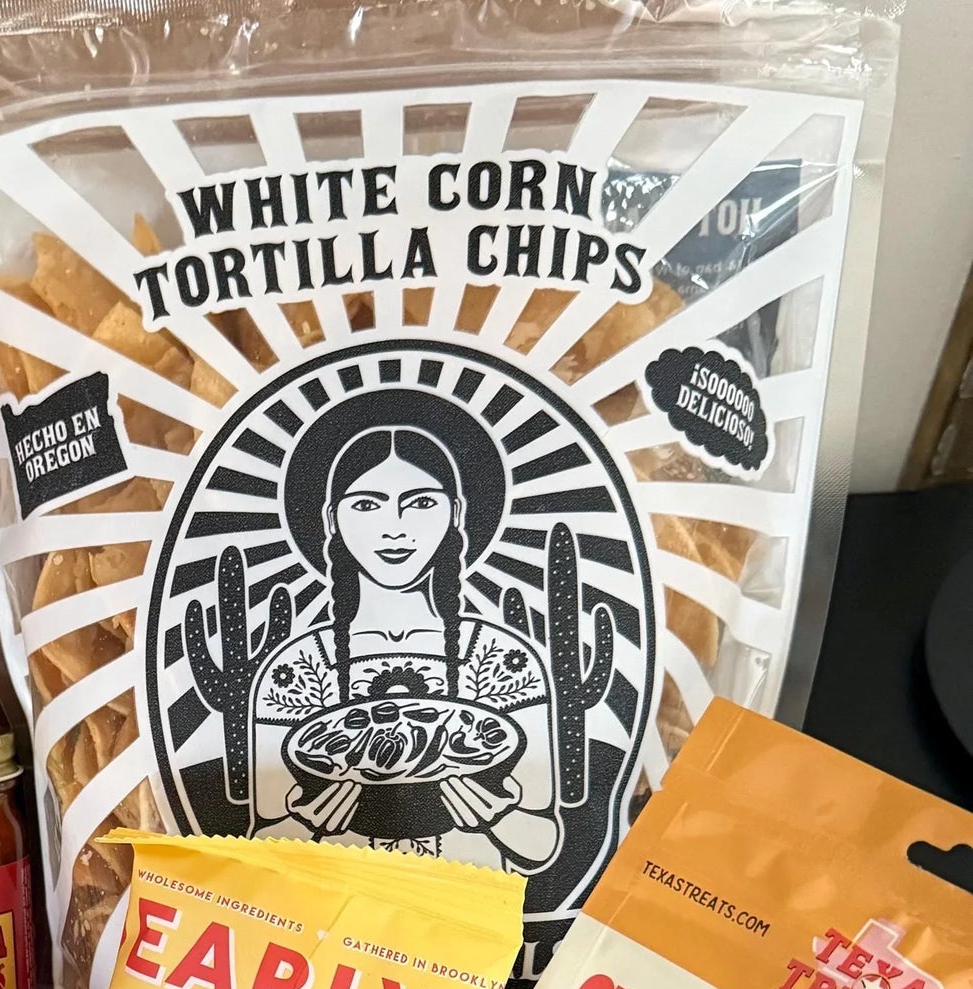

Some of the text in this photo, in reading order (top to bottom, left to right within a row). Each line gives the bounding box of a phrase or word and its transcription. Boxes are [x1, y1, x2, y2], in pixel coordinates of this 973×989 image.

[176, 159, 600, 242] WHITE CORN
[133, 224, 647, 321] TORTILLA CHIPS
[14, 405, 102, 466] HECHO EN
[675, 385, 755, 452] DELICIOSO!
[25, 433, 97, 484] OREGON
[138, 869, 214, 902] WHOLESOME
[216, 894, 304, 933] INGREDIENTS
[342, 936, 410, 965] GATHERED
[412, 955, 428, 970] IN
[641, 860, 772, 937] TEXASTREATS.COM
